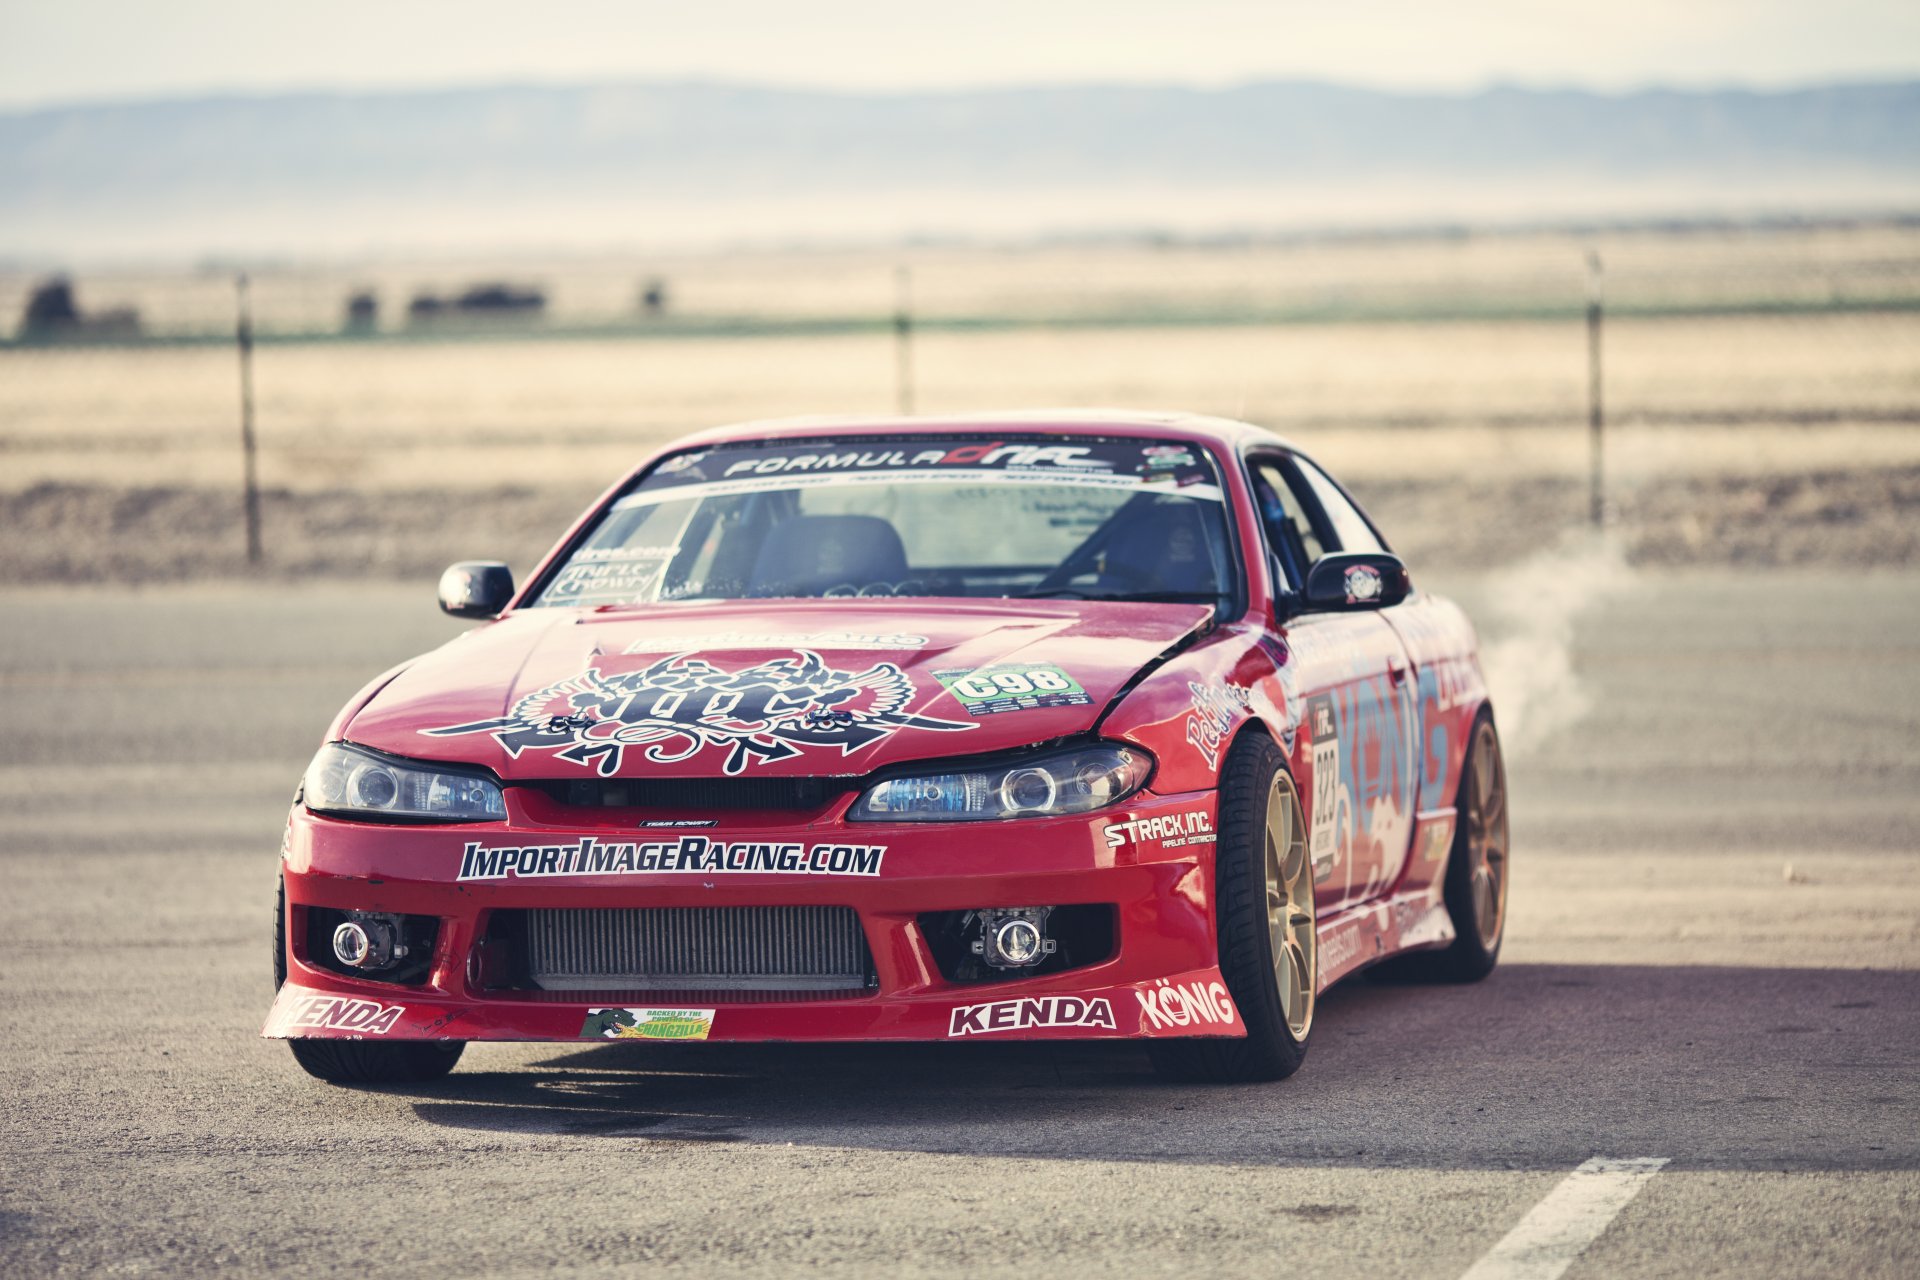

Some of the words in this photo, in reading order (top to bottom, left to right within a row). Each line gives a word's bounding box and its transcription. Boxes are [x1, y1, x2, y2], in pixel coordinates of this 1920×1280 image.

[724, 451, 946, 477] FORMULA
[953, 670, 1071, 698] C98
[1316, 748, 1336, 826] 323
[949, 996, 1116, 1037] KENDA
[1135, 978, 1234, 1030] KÖNIG
